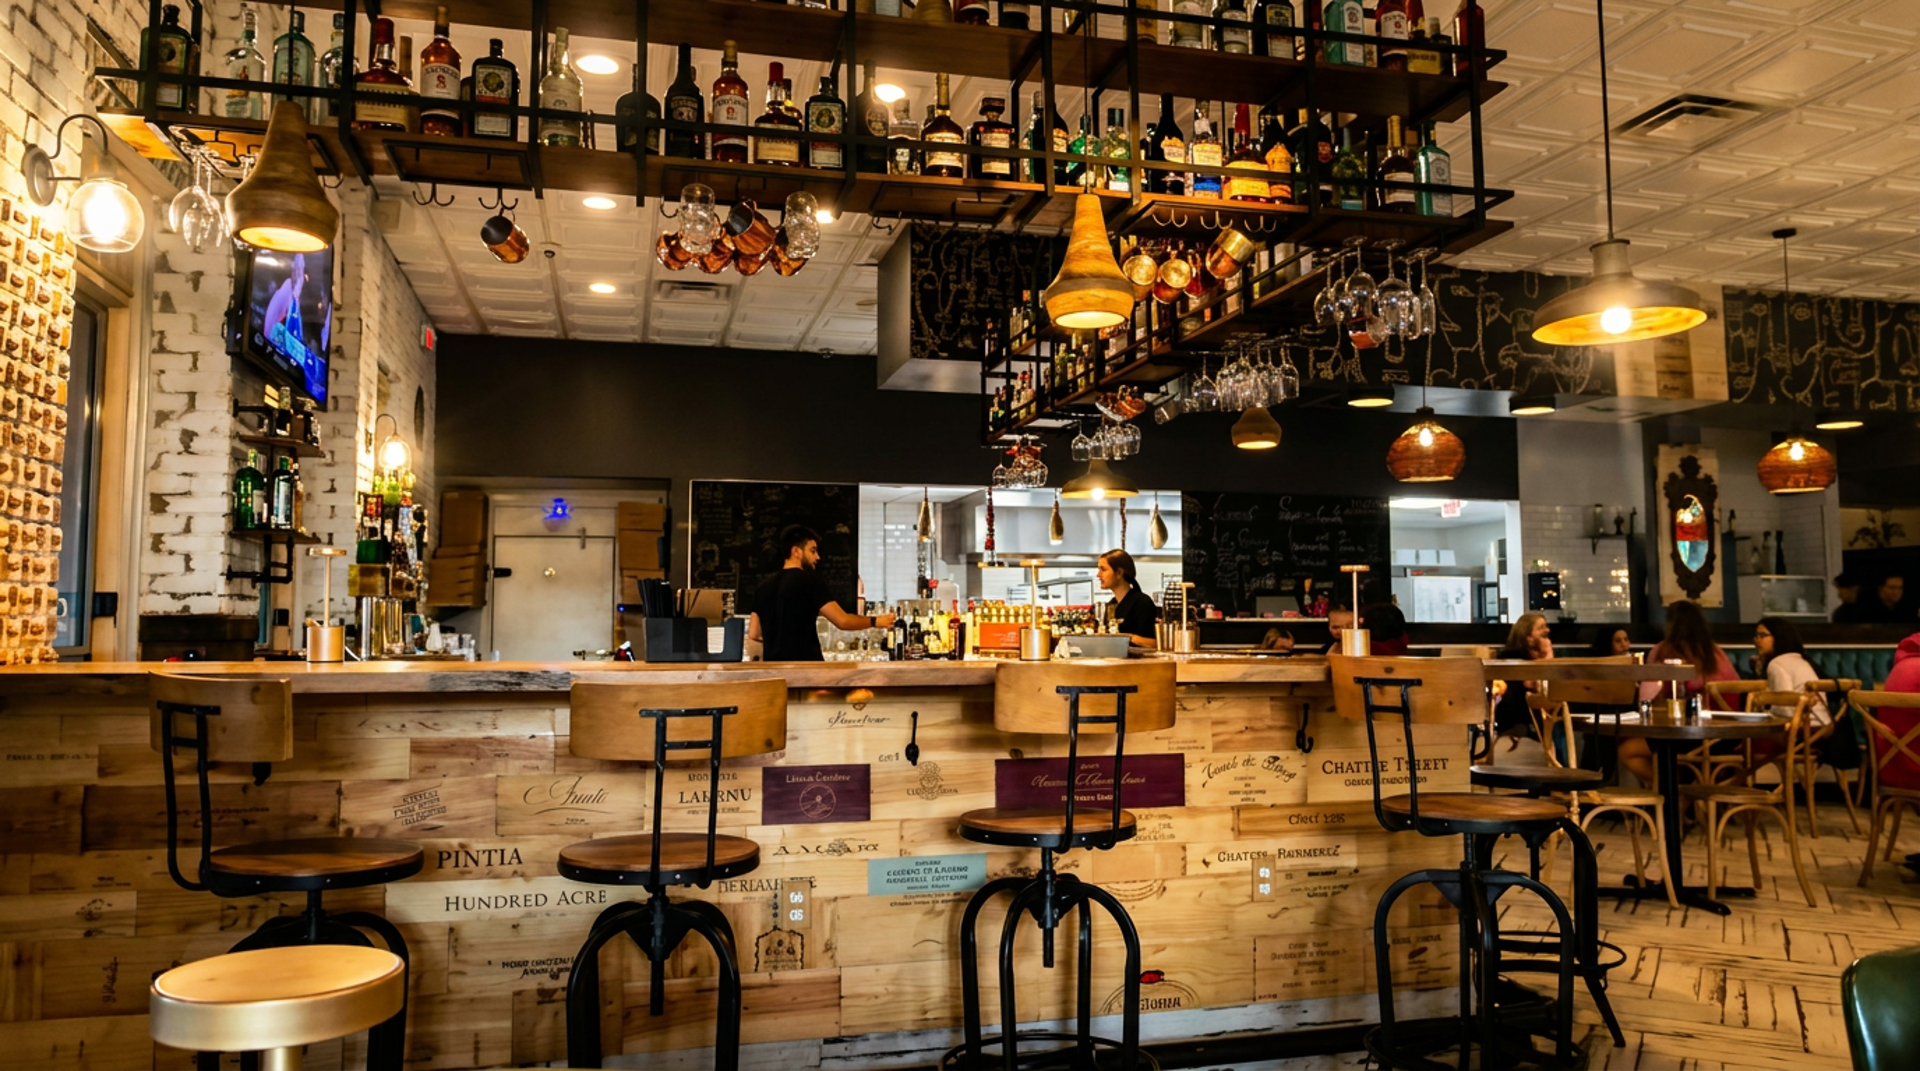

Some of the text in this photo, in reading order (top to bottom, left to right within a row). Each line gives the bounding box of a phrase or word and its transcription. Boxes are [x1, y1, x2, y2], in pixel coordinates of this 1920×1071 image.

[436, 847, 524, 870] PINTIA
[444, 889, 608, 912] HUNDRED ACRE
